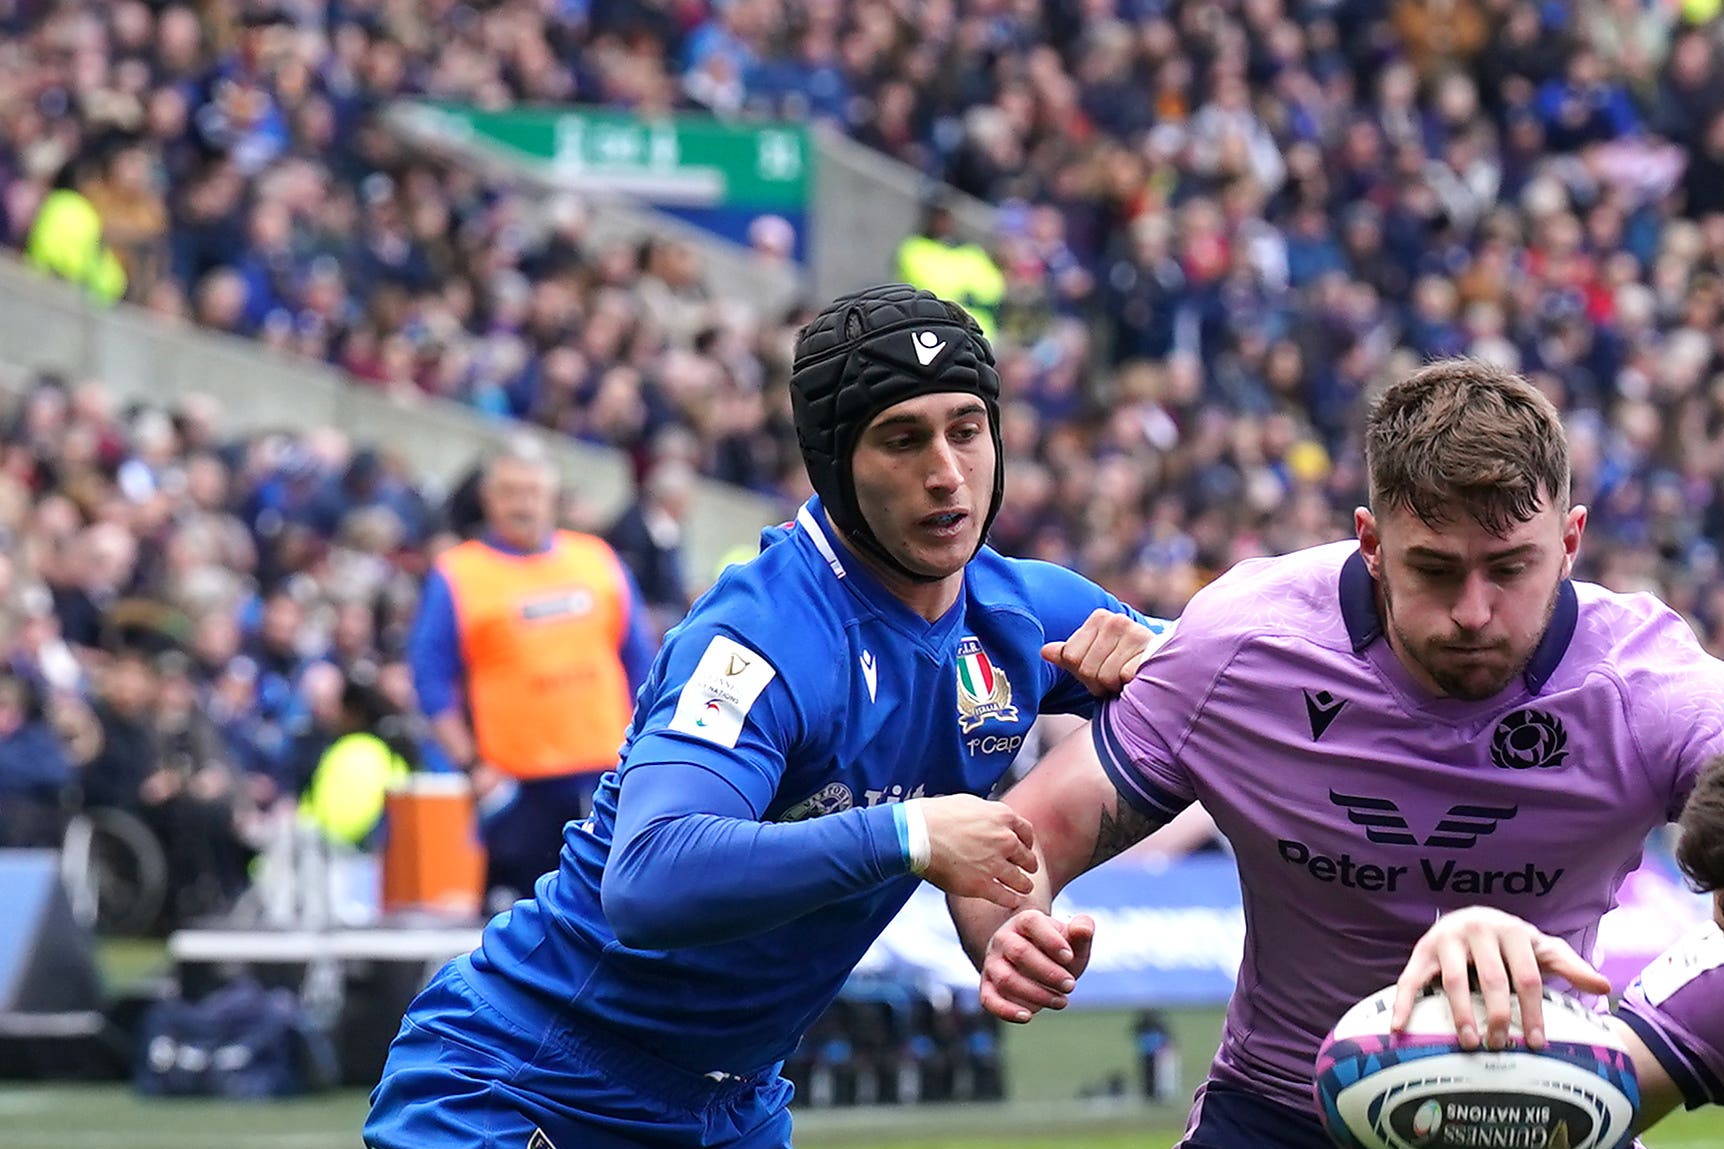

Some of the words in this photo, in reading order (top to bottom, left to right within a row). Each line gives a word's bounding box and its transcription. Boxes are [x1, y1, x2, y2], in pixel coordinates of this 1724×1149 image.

[1278, 838, 1408, 892] Peter
[1419, 858, 1565, 897] Vardy
[1446, 1103, 1521, 1122] NATIONS
[1525, 1106, 1551, 1124] SIX
[1443, 1124, 1548, 1149] GUINNESS
